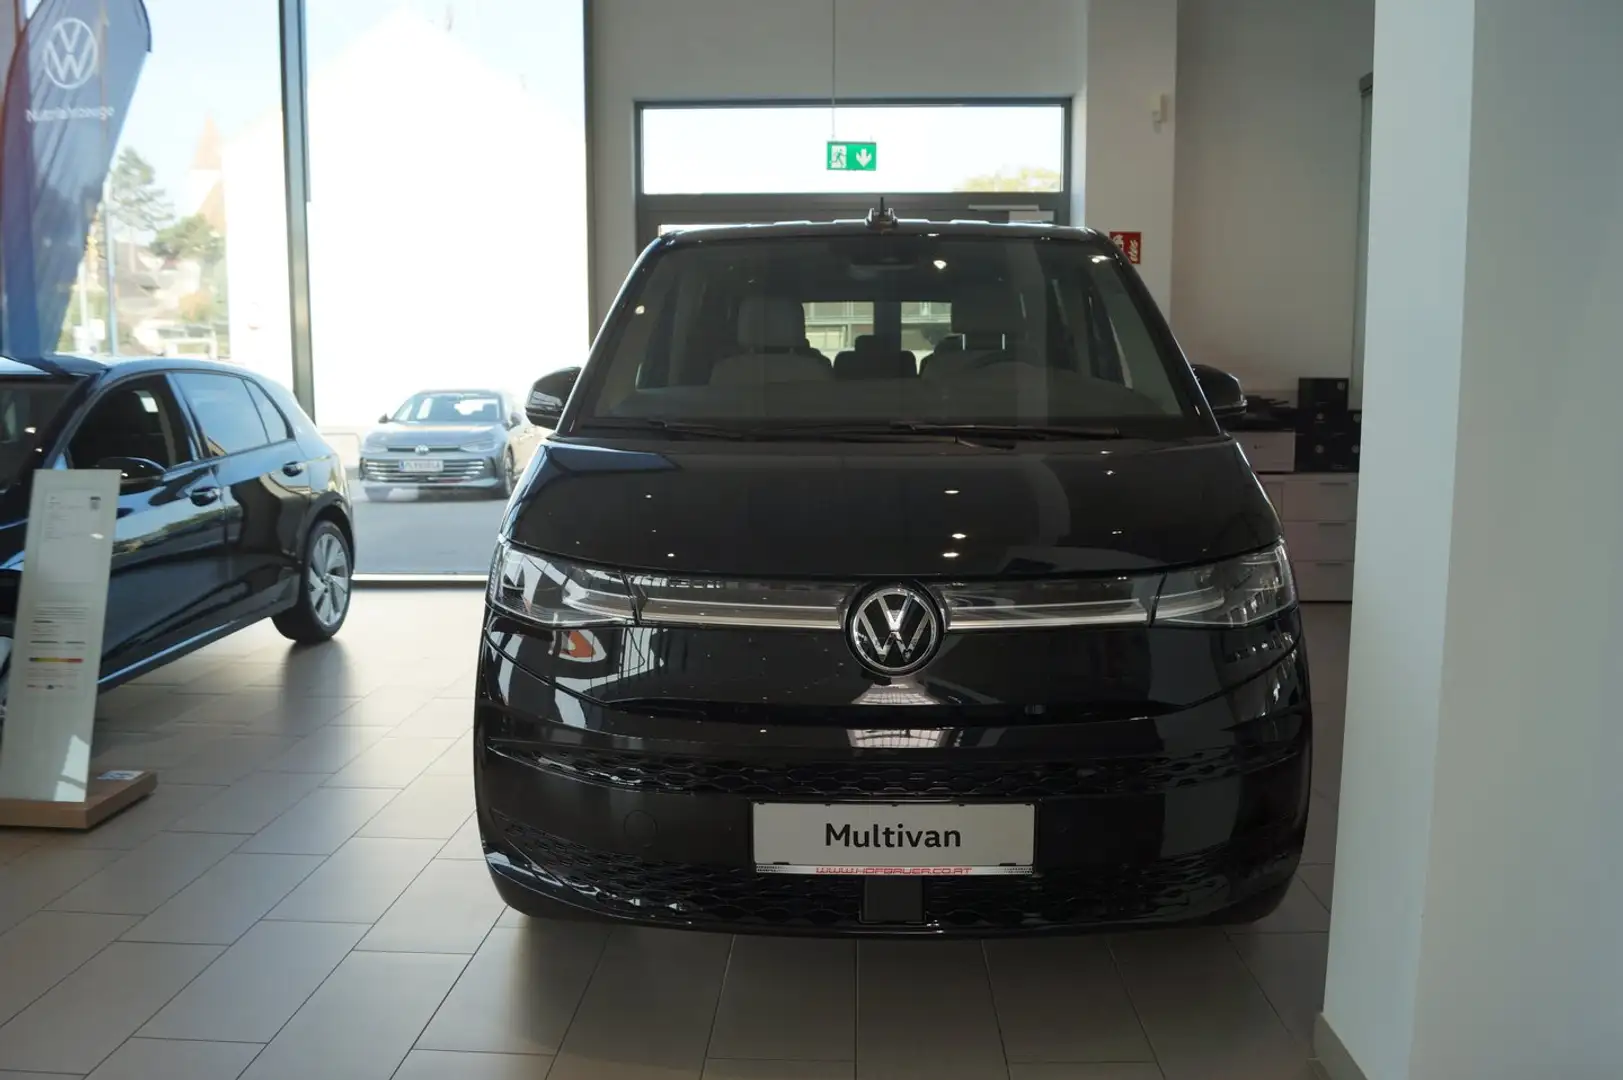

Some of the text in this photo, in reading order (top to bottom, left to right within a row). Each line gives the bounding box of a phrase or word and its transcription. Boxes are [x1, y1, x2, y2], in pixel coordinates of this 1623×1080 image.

[45, 19, 96, 86] VW
[855, 590, 933, 666] VW
[825, 822, 961, 848] Multivan
